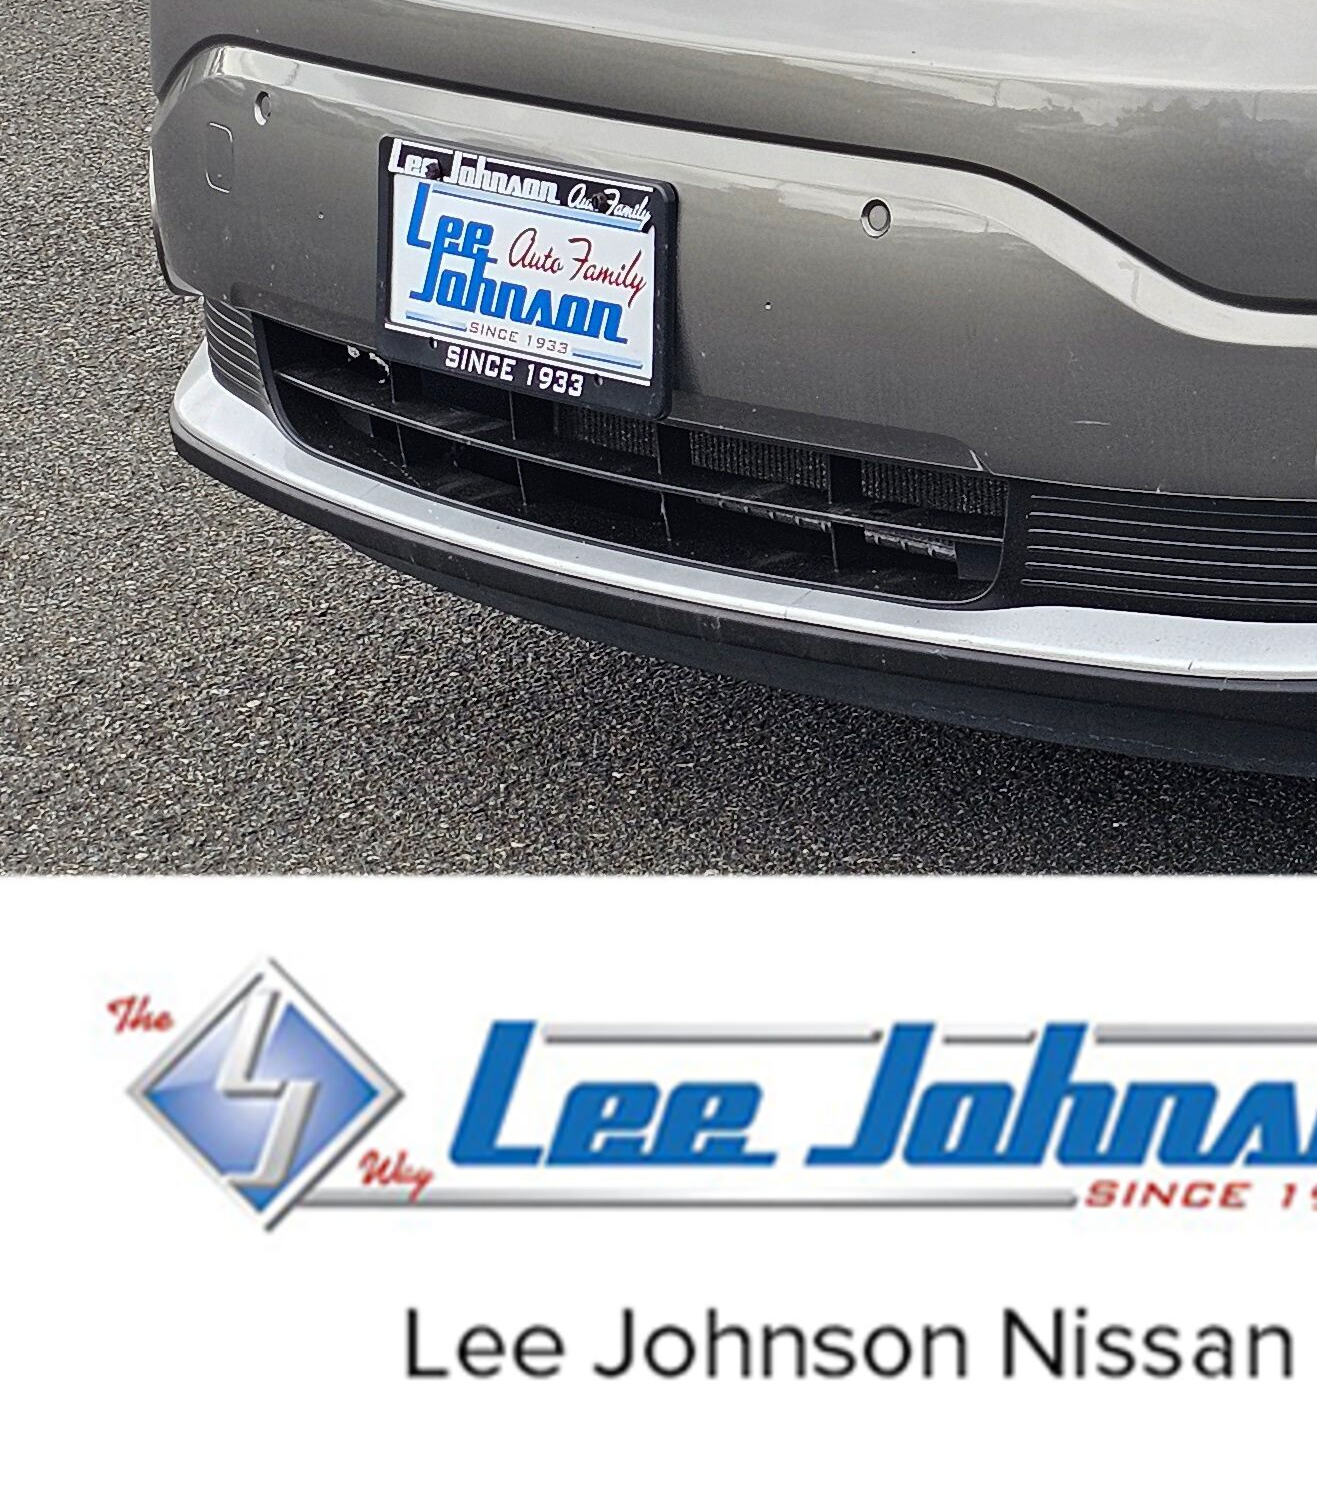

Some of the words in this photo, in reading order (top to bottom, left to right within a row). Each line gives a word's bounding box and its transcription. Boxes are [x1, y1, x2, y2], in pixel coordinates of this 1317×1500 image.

[443, 150, 560, 205] Johnson
[603, 188, 652, 231] Family
[407, 182, 498, 263] Lee
[508, 228, 564, 274] Auto
[568, 238, 647, 308] Family
[409, 236, 628, 344] Johnson
[445, 345, 517, 381] SINCE
[526, 364, 584, 397] 1933
[469, 322, 519, 344] SINCE
[527, 334, 569, 355] 1933
